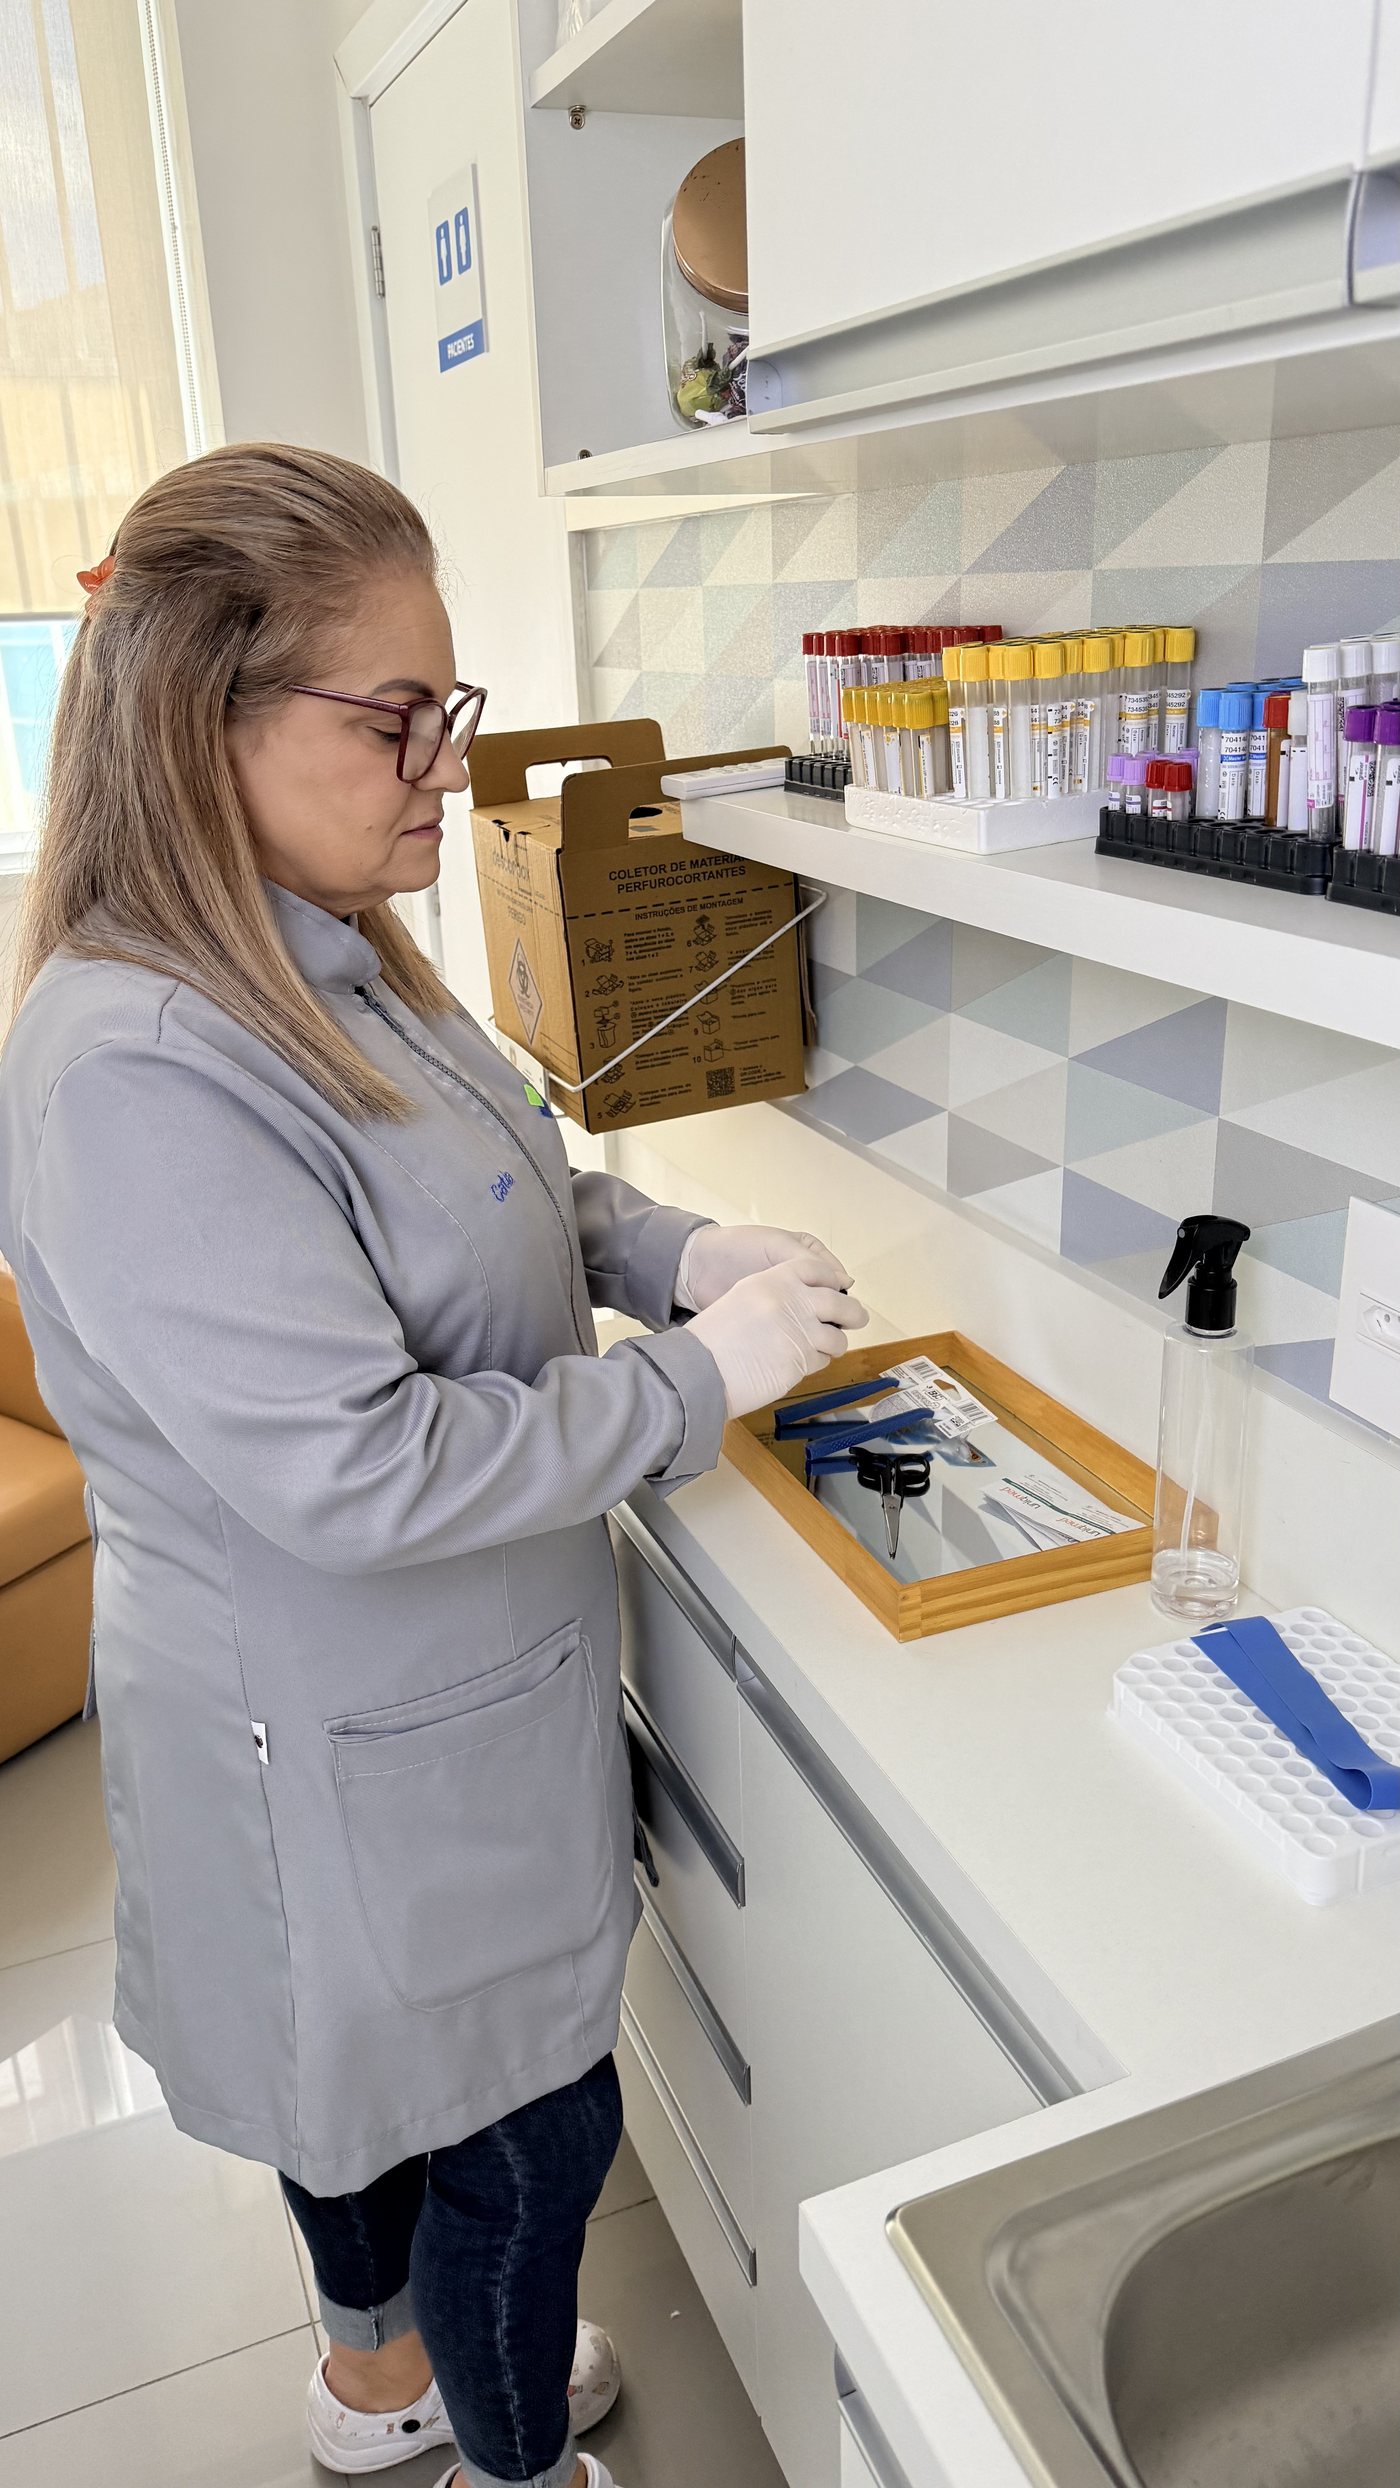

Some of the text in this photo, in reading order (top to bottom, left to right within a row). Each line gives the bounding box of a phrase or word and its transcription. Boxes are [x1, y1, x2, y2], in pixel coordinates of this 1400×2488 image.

[447, 333, 474, 359] PACIENTES
[609, 853, 747, 882] COLETOR DE MATERIA
[617, 866, 746, 893] PERFUROCORTANTES
[635, 898, 744, 921] INSTRUÇÕES DE MONTAGEM
[585, 990, 590, 998] 2
